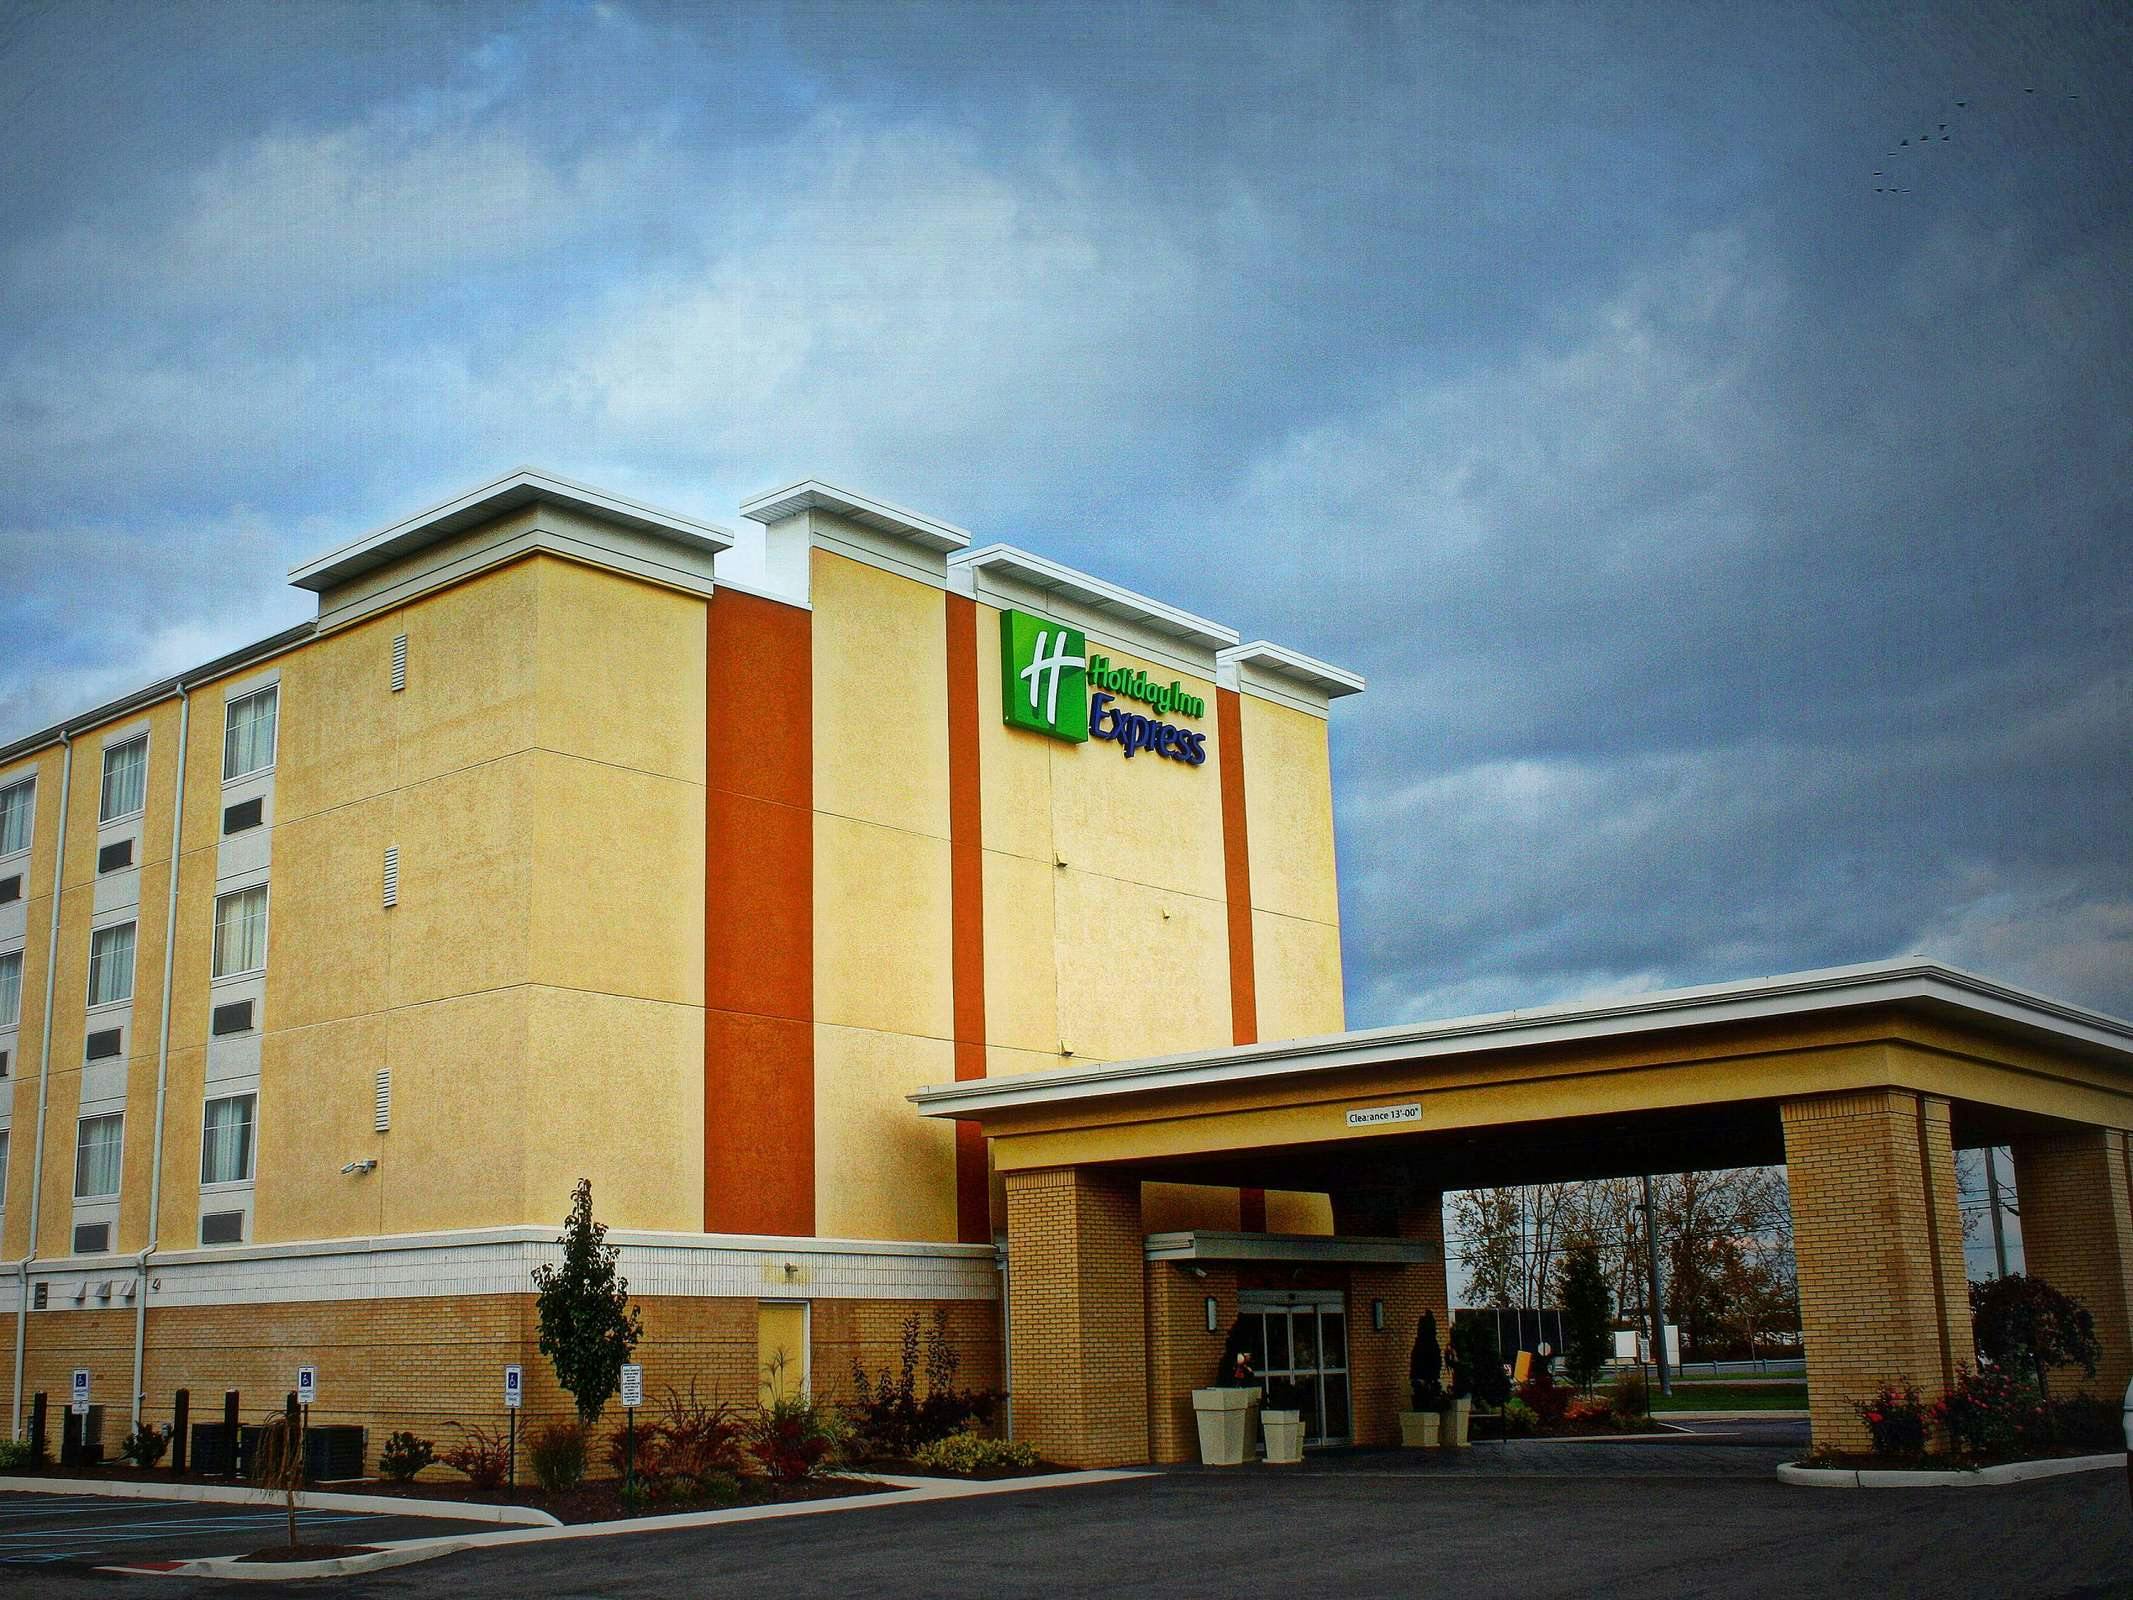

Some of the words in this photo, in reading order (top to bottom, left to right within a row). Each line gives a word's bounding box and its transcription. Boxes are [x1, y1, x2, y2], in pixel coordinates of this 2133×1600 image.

[1088, 654, 1168, 714] Holiday
[1170, 681, 1206, 719] Inn
[1089, 692, 1206, 765] Express
[1349, 1111, 1389, 1123] Clearance
